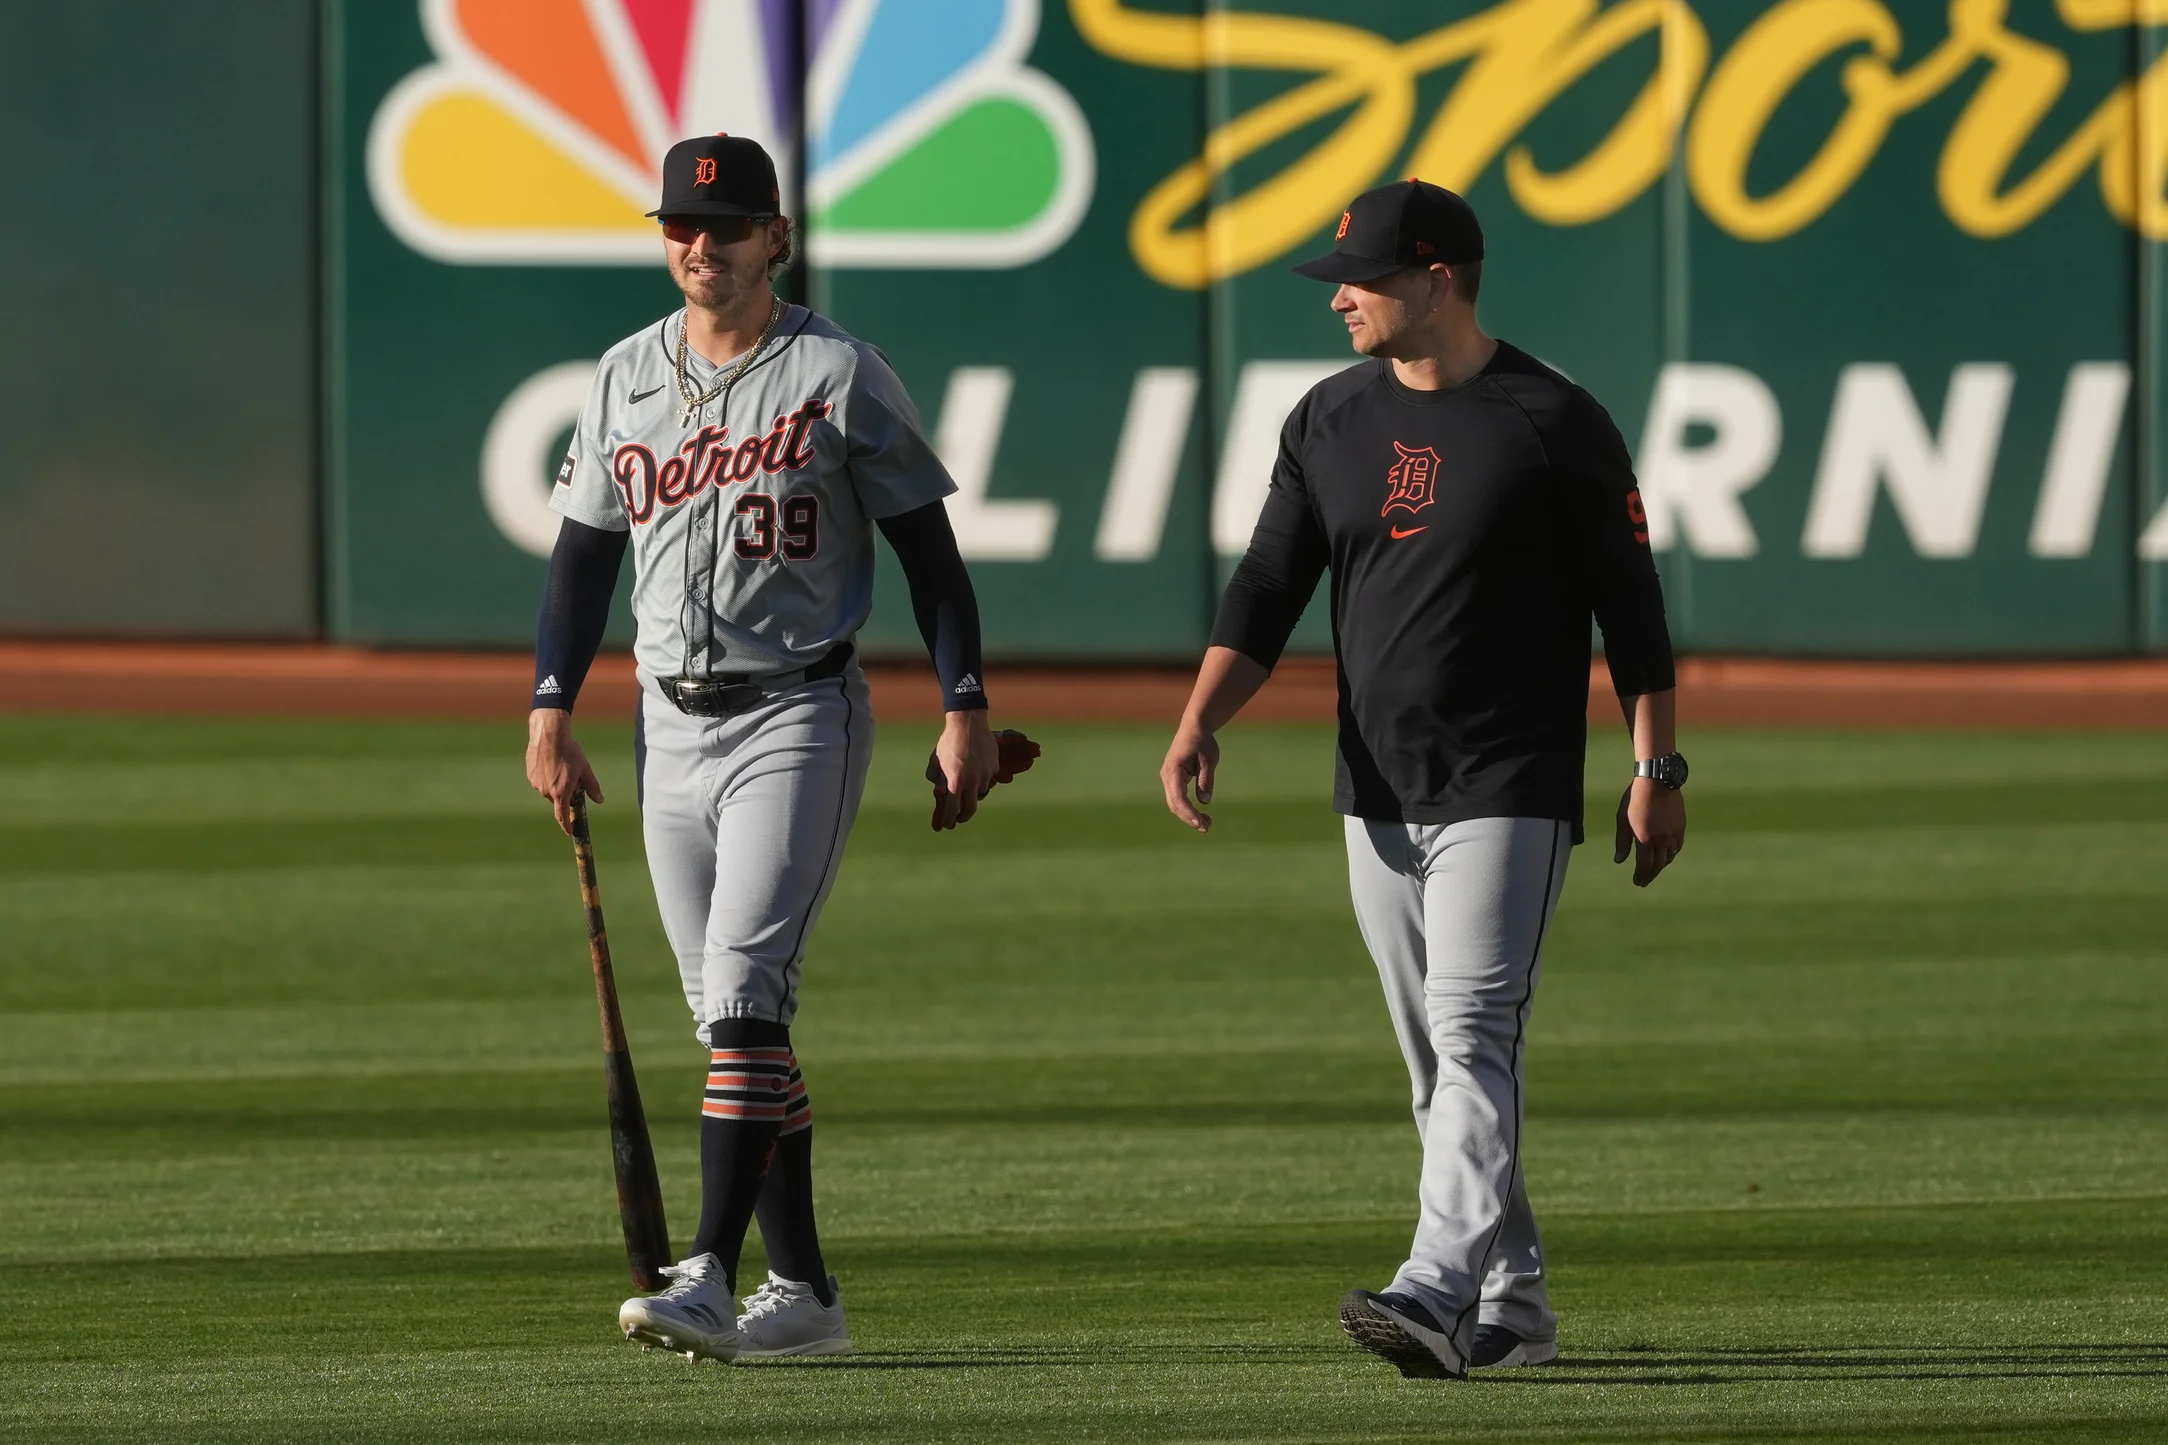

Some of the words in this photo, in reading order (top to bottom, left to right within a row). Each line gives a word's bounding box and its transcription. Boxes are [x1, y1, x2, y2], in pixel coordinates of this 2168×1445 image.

[693, 156, 718, 188] D
[612, 398, 834, 528] Detroit
[1381, 440, 1441, 518] D
[734, 493, 819, 561] 39
[536, 685, 562, 696] adidas
